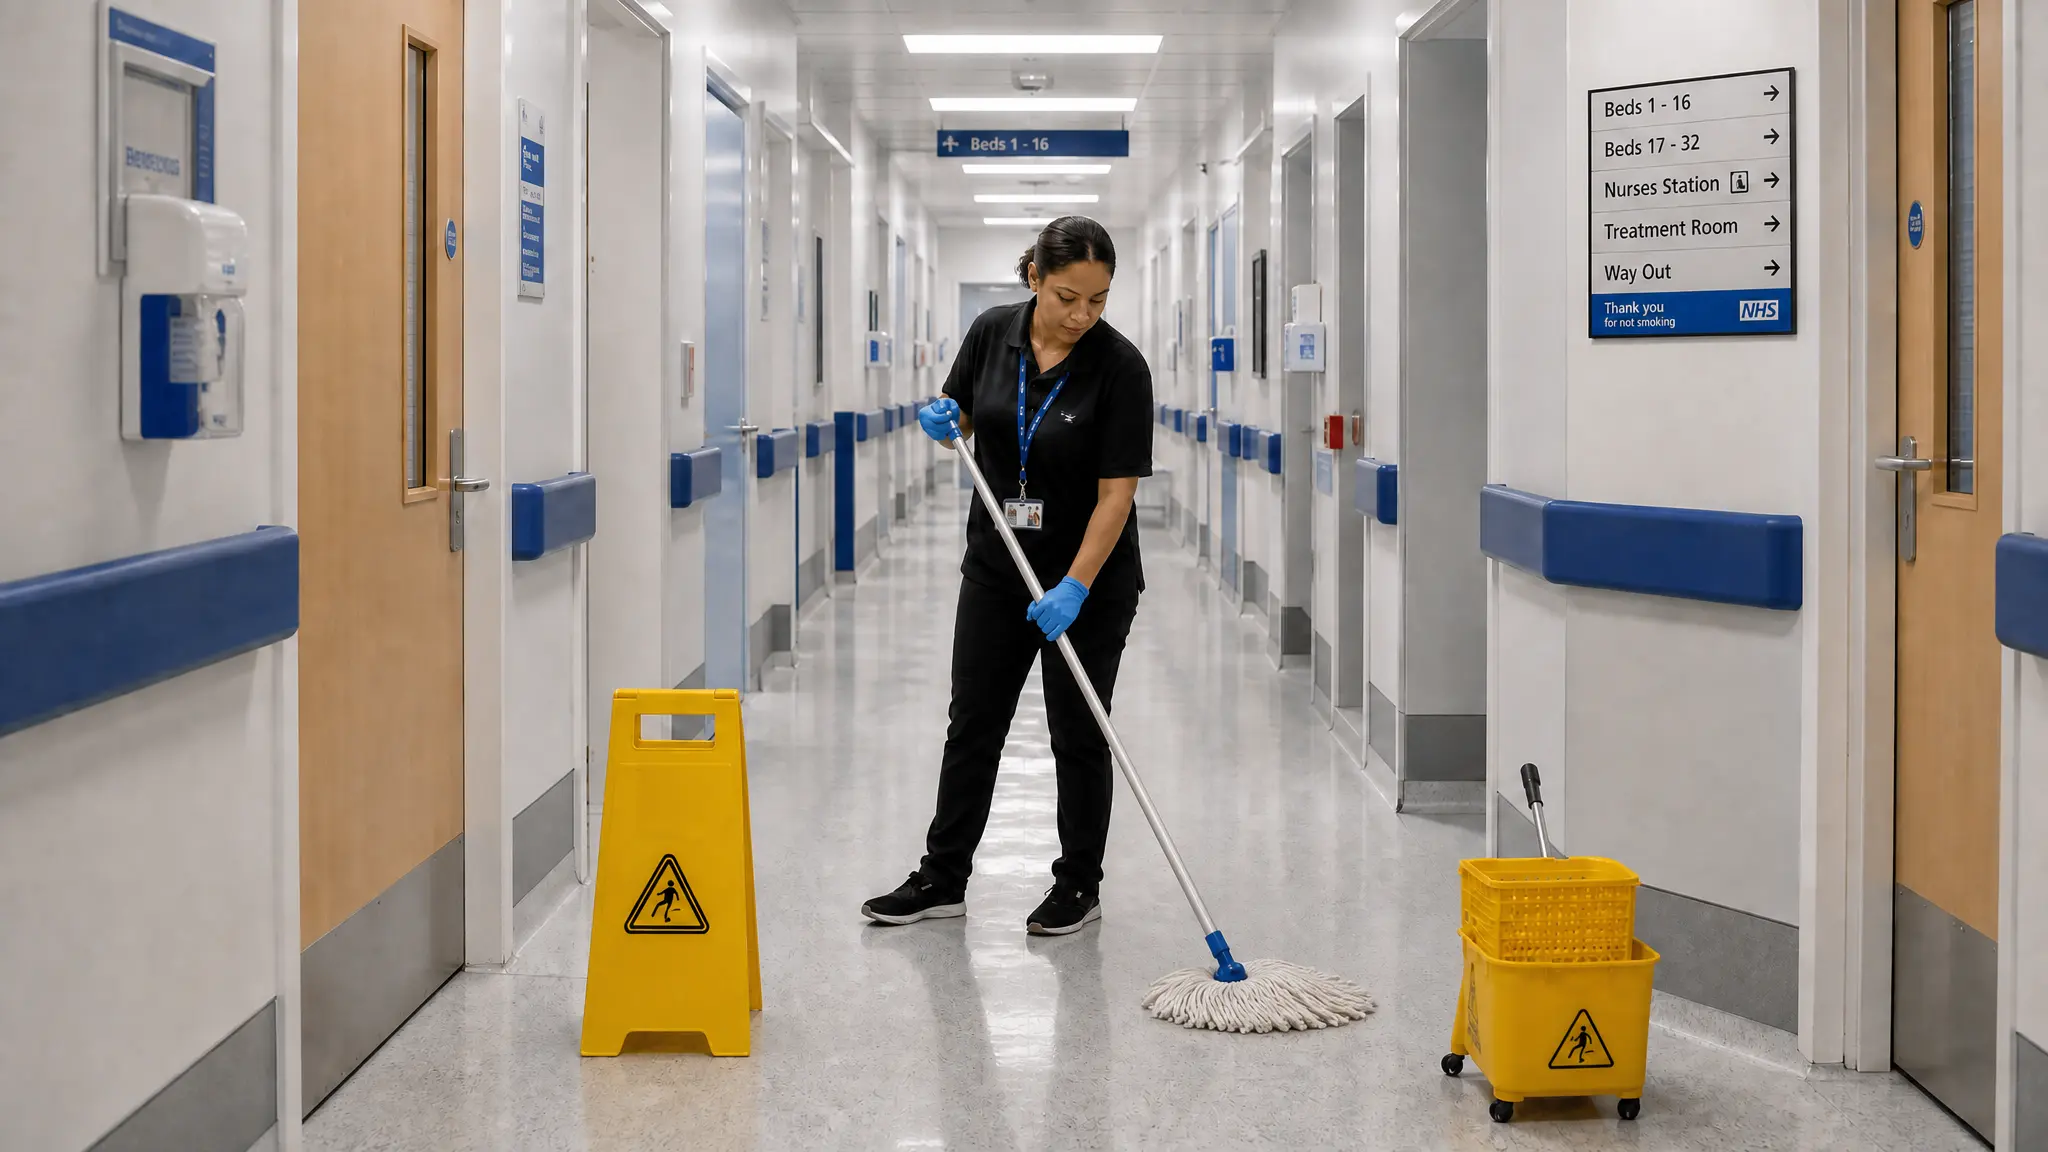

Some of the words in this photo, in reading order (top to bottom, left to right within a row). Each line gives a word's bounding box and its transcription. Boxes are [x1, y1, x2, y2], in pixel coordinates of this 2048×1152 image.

[1605, 99, 1642, 117] Beds
[1648, 98, 1655, 113] 1
[1672, 94, 1690, 110] 16
[971, 137, 1006, 151] Beds
[1010, 138, 1017, 151] 1
[1032, 138, 1049, 151] 16
[1605, 139, 1641, 157] Beds
[1648, 138, 1664, 153] 17
[1682, 134, 1699, 151] 32
[1605, 182, 1657, 198] Nurses
[1663, 176, 1719, 194] Station
[1604, 221, 1686, 239] Treatment
[1692, 220, 1737, 235] Room
[1605, 265, 1637, 284] Way
[1643, 264, 1671, 279] Out
[1605, 301, 1639, 313] Thank
[1643, 304, 1664, 316] you
[1741, 303, 1777, 318] NHS
[1605, 317, 1617, 327] for
[1620, 319, 1634, 327] not
[1637, 317, 1675, 328] smoking
